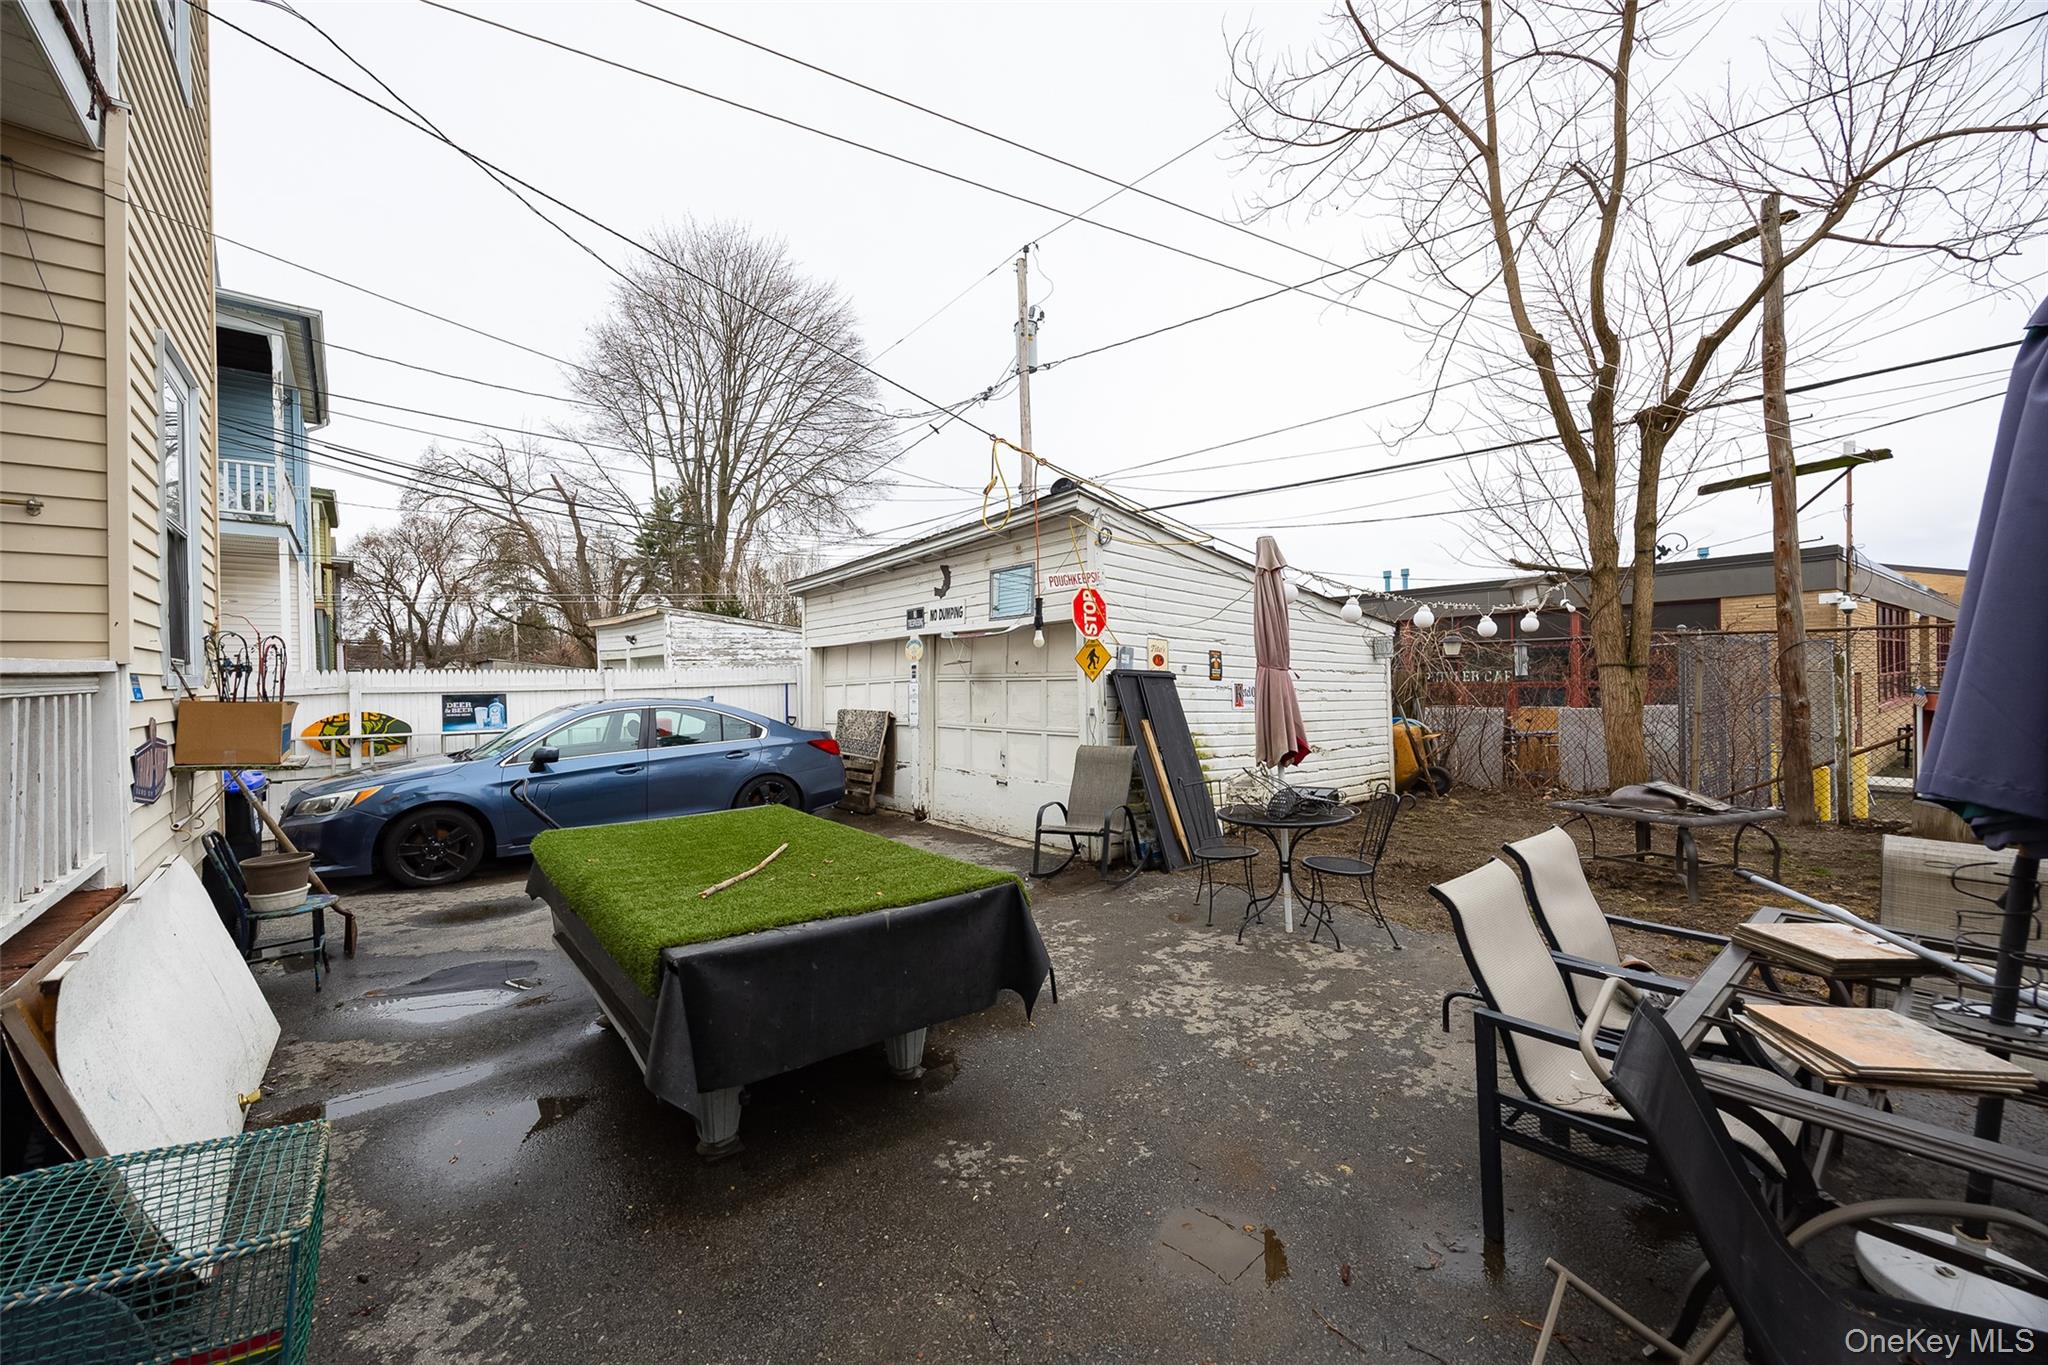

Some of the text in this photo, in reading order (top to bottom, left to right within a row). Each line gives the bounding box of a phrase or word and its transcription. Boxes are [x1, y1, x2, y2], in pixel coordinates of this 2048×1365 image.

[929, 605, 963, 621] NO DUMPING
[1083, 589, 1098, 636] STOP
